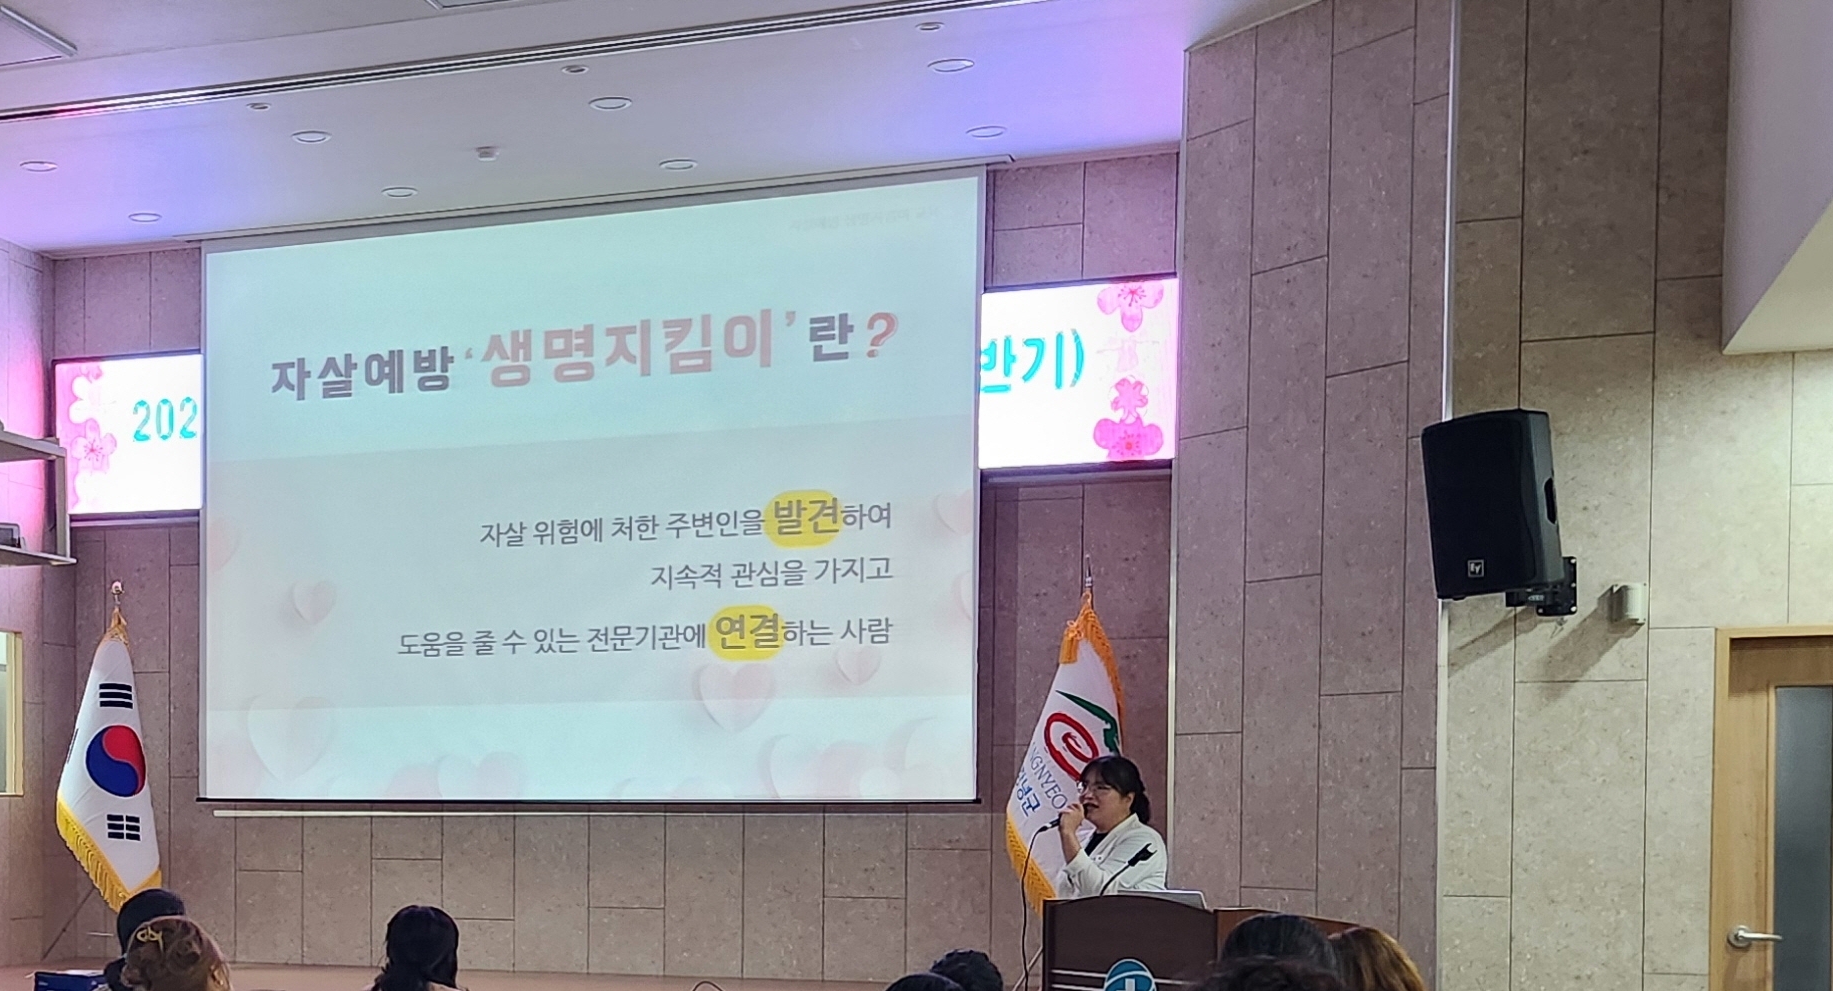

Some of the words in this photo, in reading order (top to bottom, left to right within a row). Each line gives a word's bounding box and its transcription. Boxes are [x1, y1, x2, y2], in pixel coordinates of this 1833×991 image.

[271, 346, 455, 401] 자살예방
[480, 521, 528, 548] 자살
[533, 517, 603, 546] 위험에
[611, 514, 660, 542] 처한
[665, 509, 765, 539] 주변인을
[774, 497, 892, 536] 발견하여
[651, 562, 722, 591] 지속적
[730, 559, 808, 588] 관심을
[814, 556, 894, 585] 가지고
[397, 631, 468, 658] 도움을
[472, 630, 497, 656] 줄
[502, 629, 527, 655] 수
[533, 627, 581, 654] 있는
[586, 622, 707, 653] 전문기관에
[715, 612, 834, 650] 연결하는
[840, 617, 894, 645] 사람
